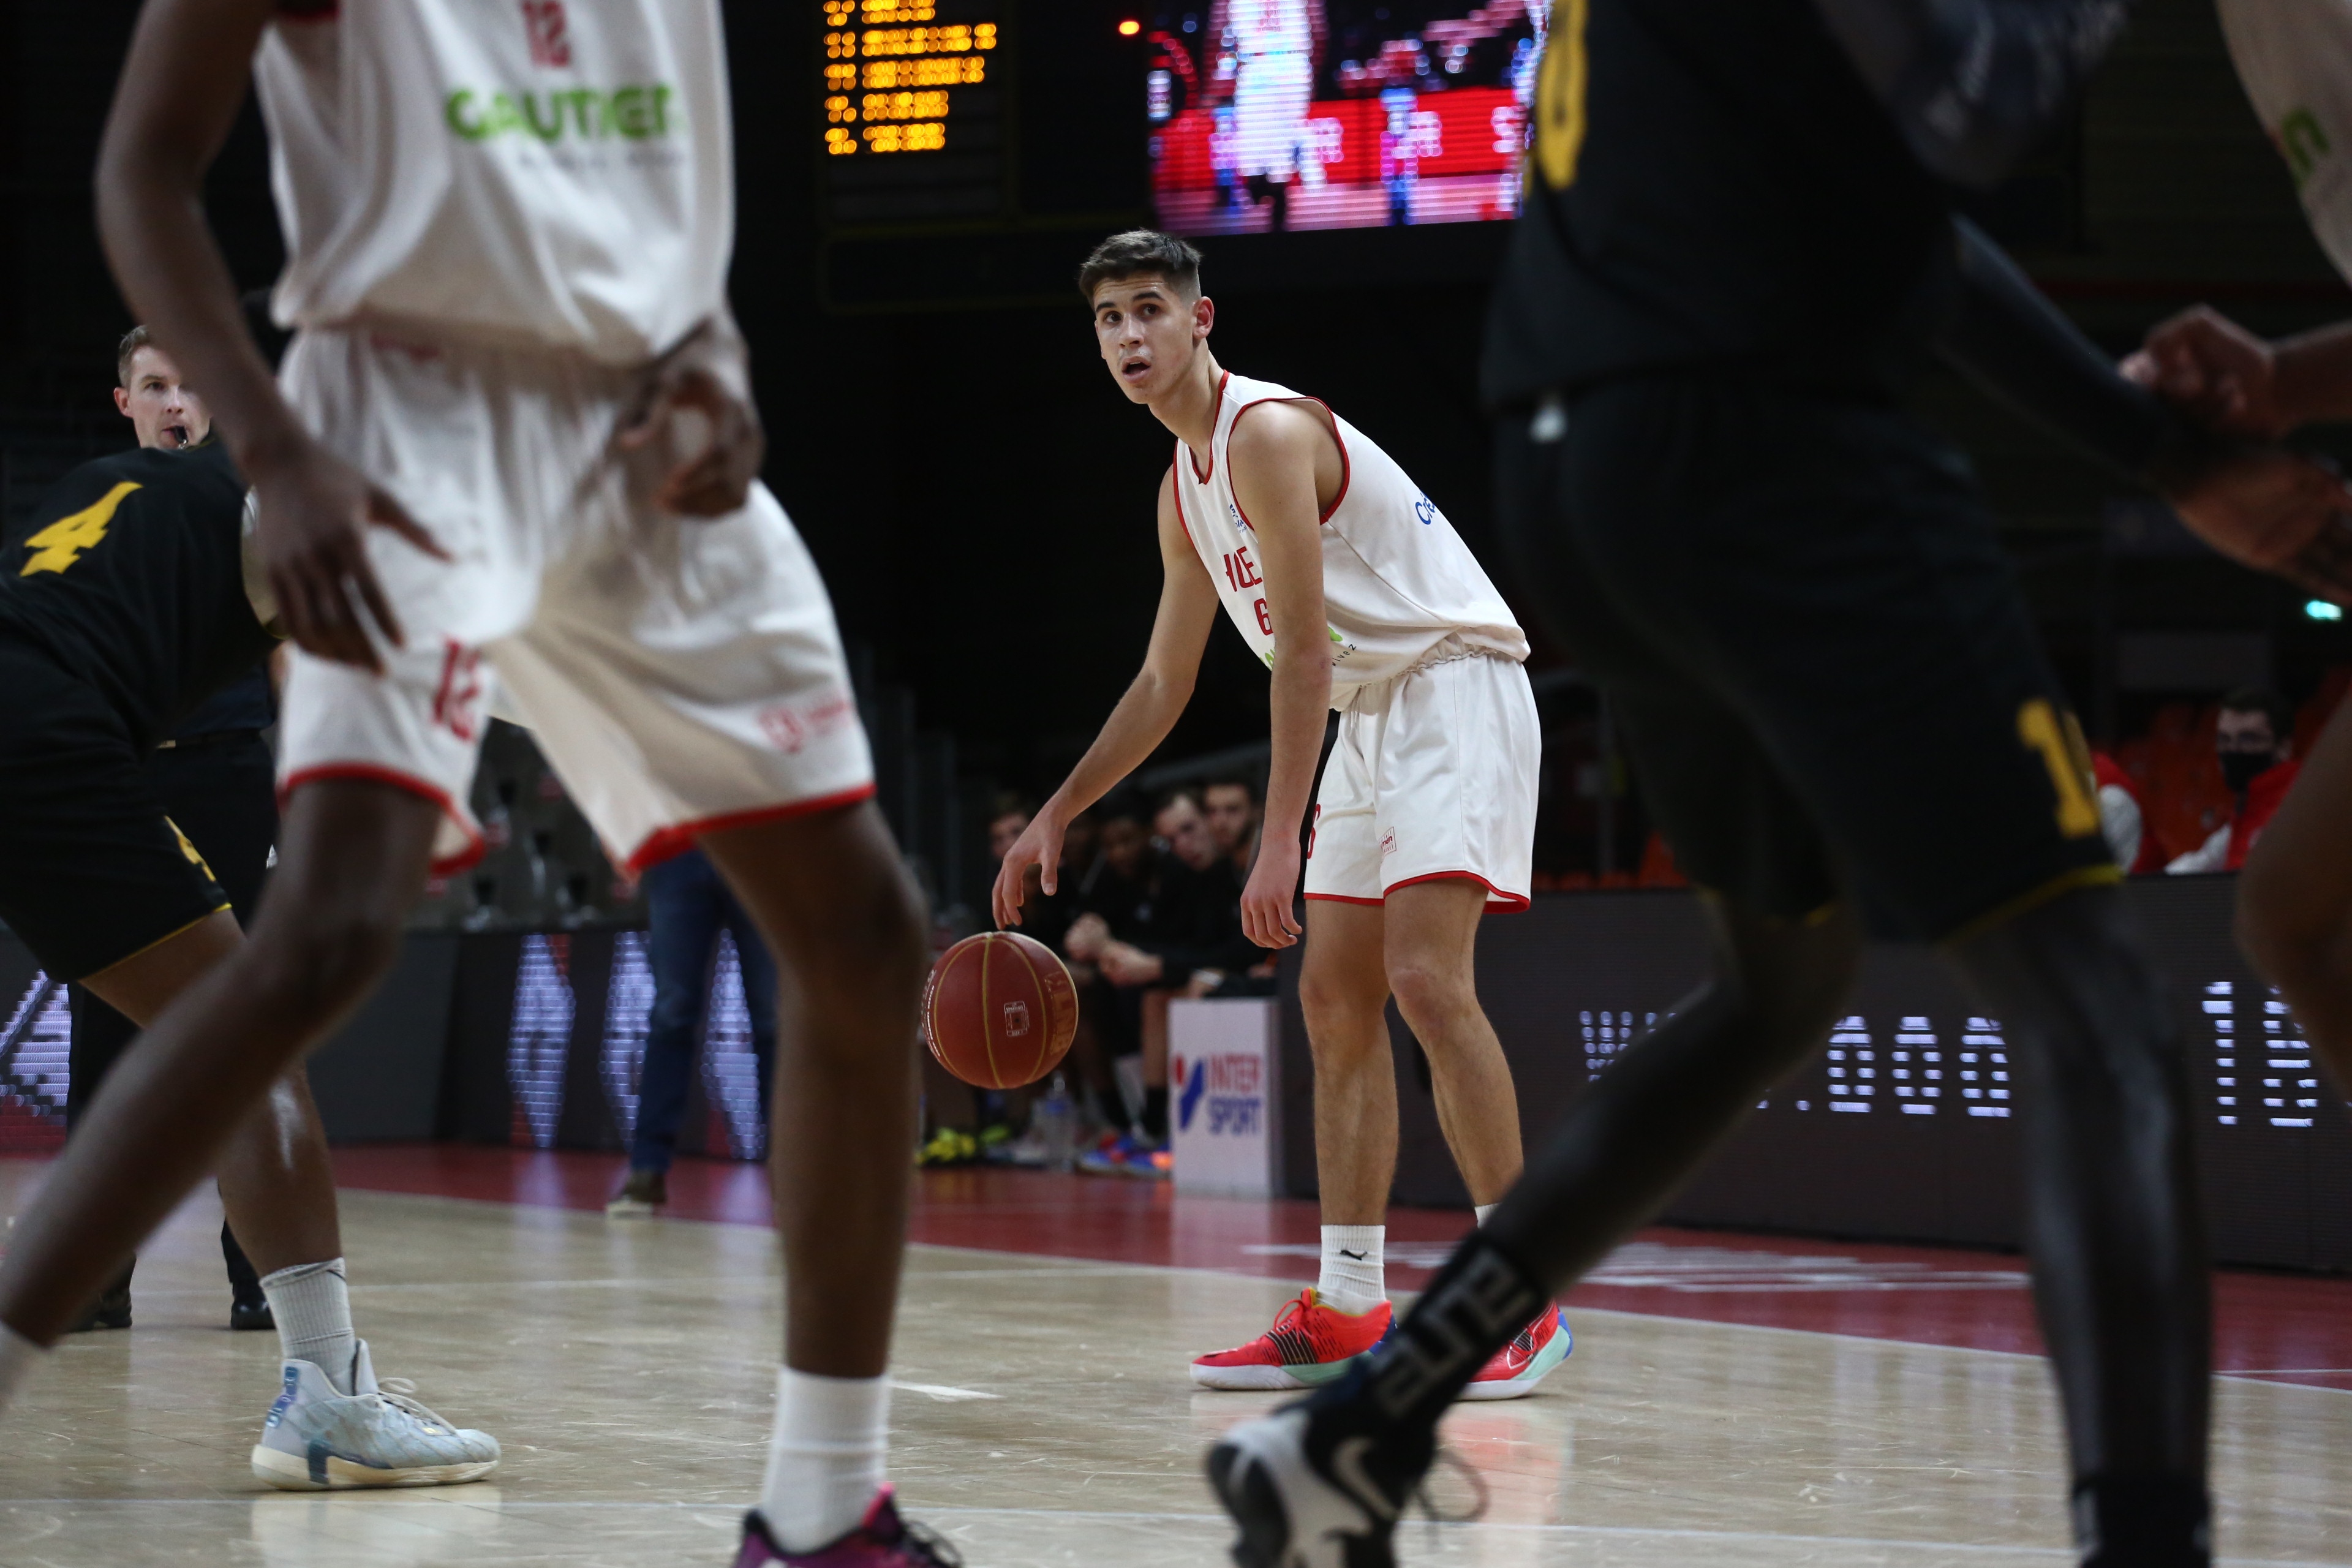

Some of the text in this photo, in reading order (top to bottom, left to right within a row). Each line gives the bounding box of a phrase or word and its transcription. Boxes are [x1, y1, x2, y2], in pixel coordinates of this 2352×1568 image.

[20, 480, 144, 578] 4
[1254, 598, 1273, 636] 6
[1210, 1054, 1261, 1091] INTER
[1210, 1098, 1261, 1135] SPORT
